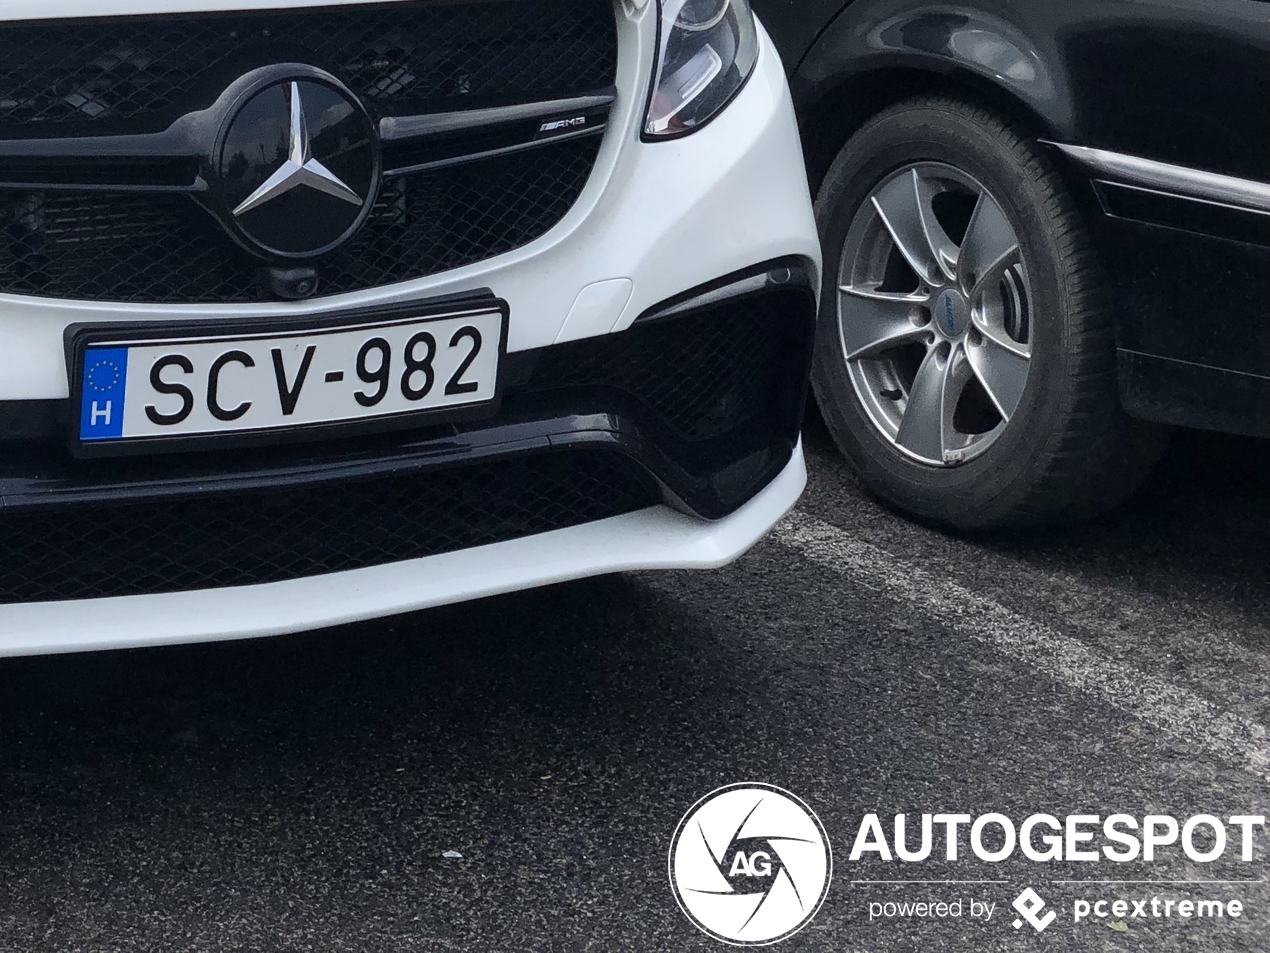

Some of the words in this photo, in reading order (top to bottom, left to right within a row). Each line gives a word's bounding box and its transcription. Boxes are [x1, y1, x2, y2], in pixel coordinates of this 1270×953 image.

[554, 116, 586, 129] AMG
[90, 400, 112, 426] H
[144, 325, 483, 426] SCV-982
